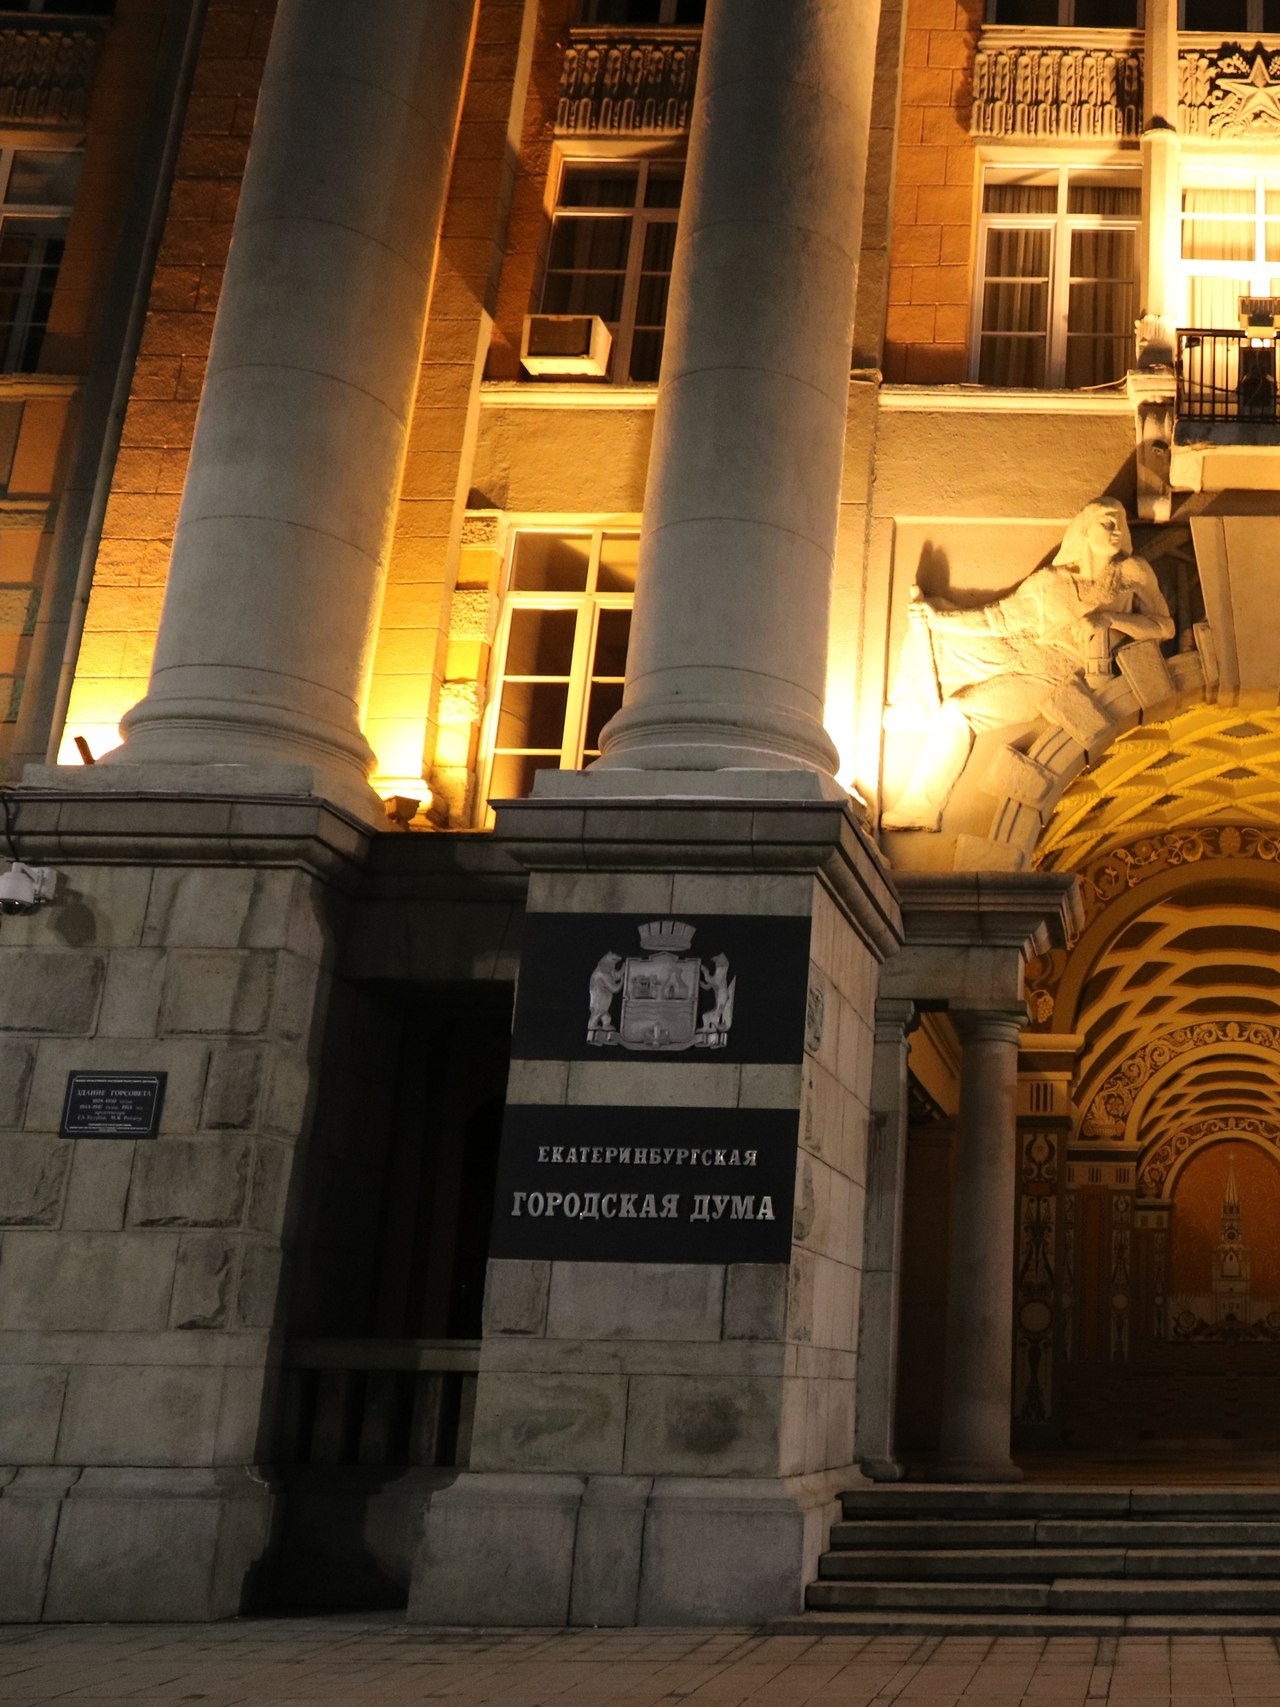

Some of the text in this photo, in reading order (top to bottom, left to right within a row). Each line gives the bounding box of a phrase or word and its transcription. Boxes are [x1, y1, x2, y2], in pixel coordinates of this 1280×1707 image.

[537, 1146, 758, 1167] ЕКАТЕРИНБУРГСКАЯ
[511, 1191, 776, 1222] ГОРОДСКАЯ ДУМА
